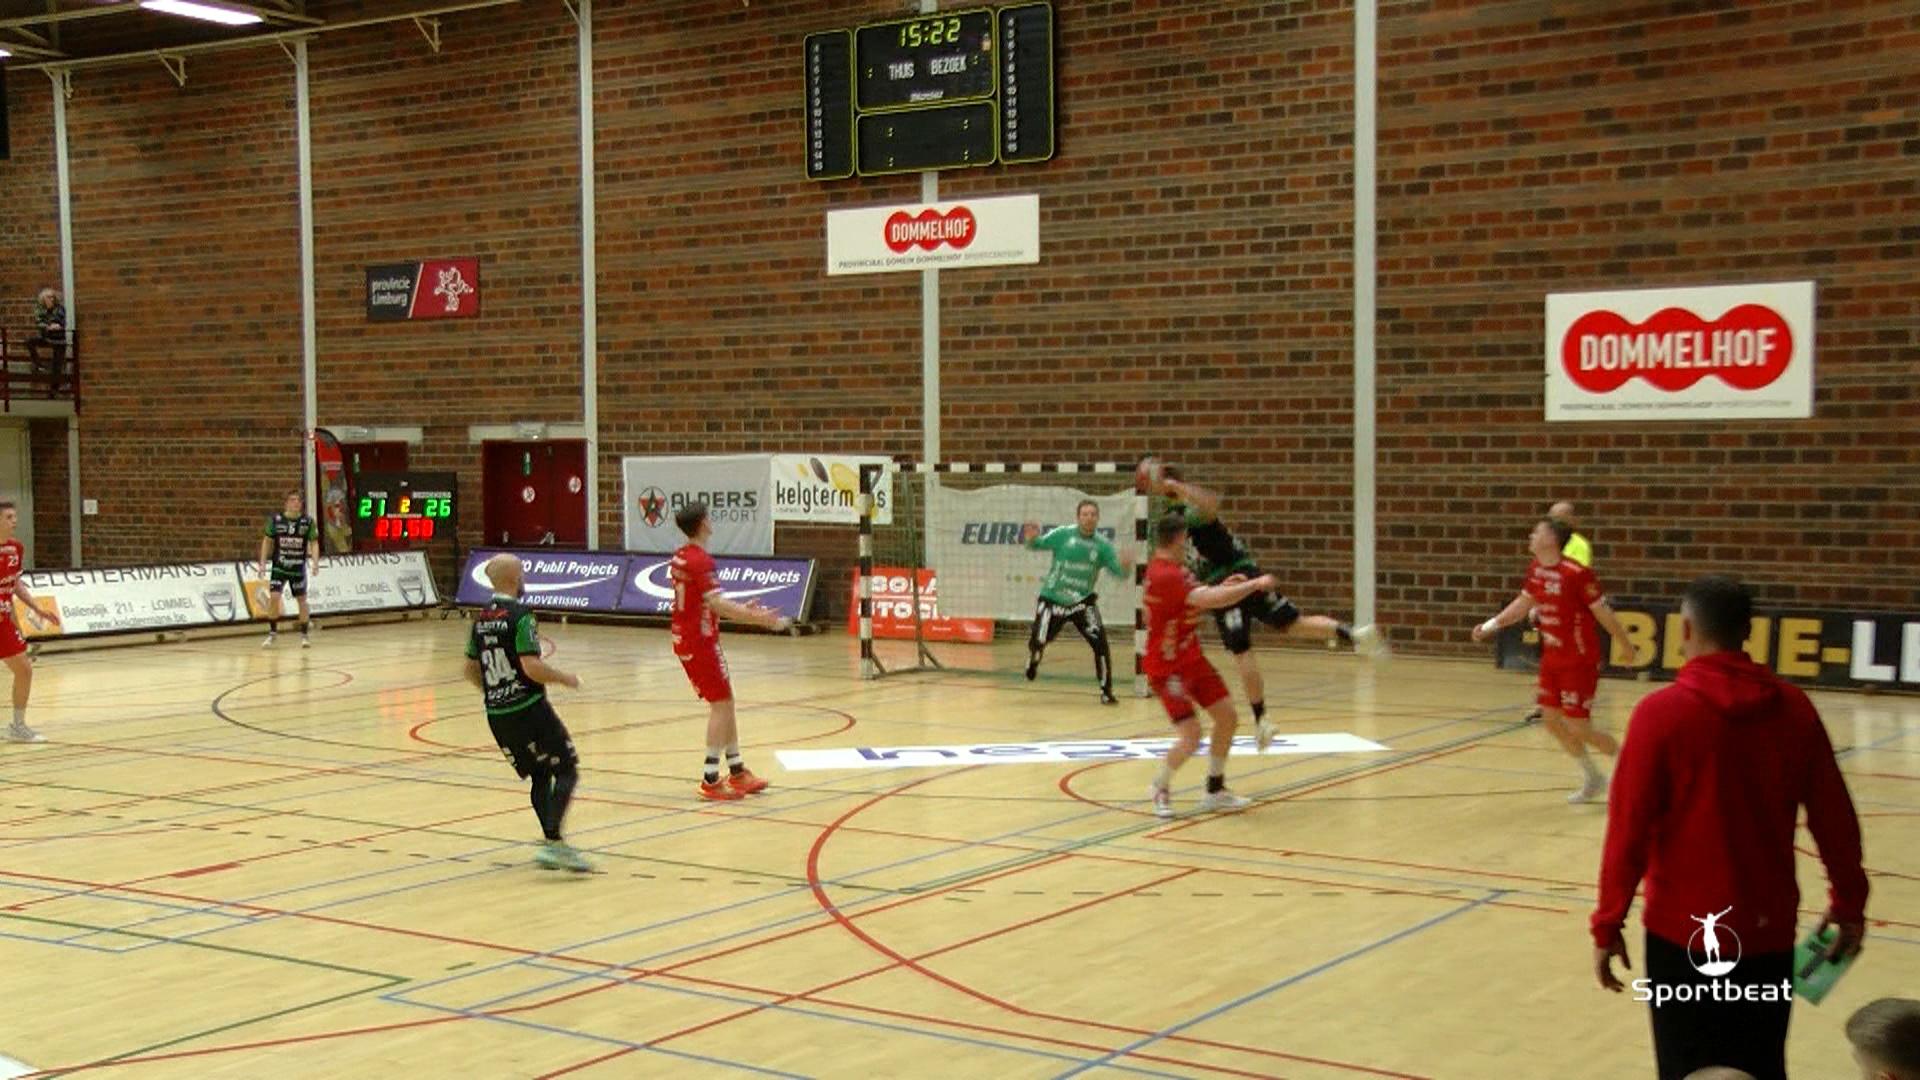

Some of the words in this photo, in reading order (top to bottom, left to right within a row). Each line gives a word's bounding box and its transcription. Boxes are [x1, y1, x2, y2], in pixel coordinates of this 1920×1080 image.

[901, 18, 961, 48] 15:22
[889, 62, 915, 80] THUIS
[930, 56, 967, 75] BEZOEK
[891, 218, 971, 243] DOMMELHOF
[1580, 328, 1778, 371] DOMMELHOF
[776, 480, 886, 513] kelgterms
[359, 499, 386, 518] 21
[426, 499, 451, 518] 26
[534, 560, 566, 573] Publi
[567, 562, 620, 577] Projects
[742, 568, 801, 584] Projects
[151, 597, 196, 611] LOMMEL
[528, 595, 589, 608] ADVERTISING
